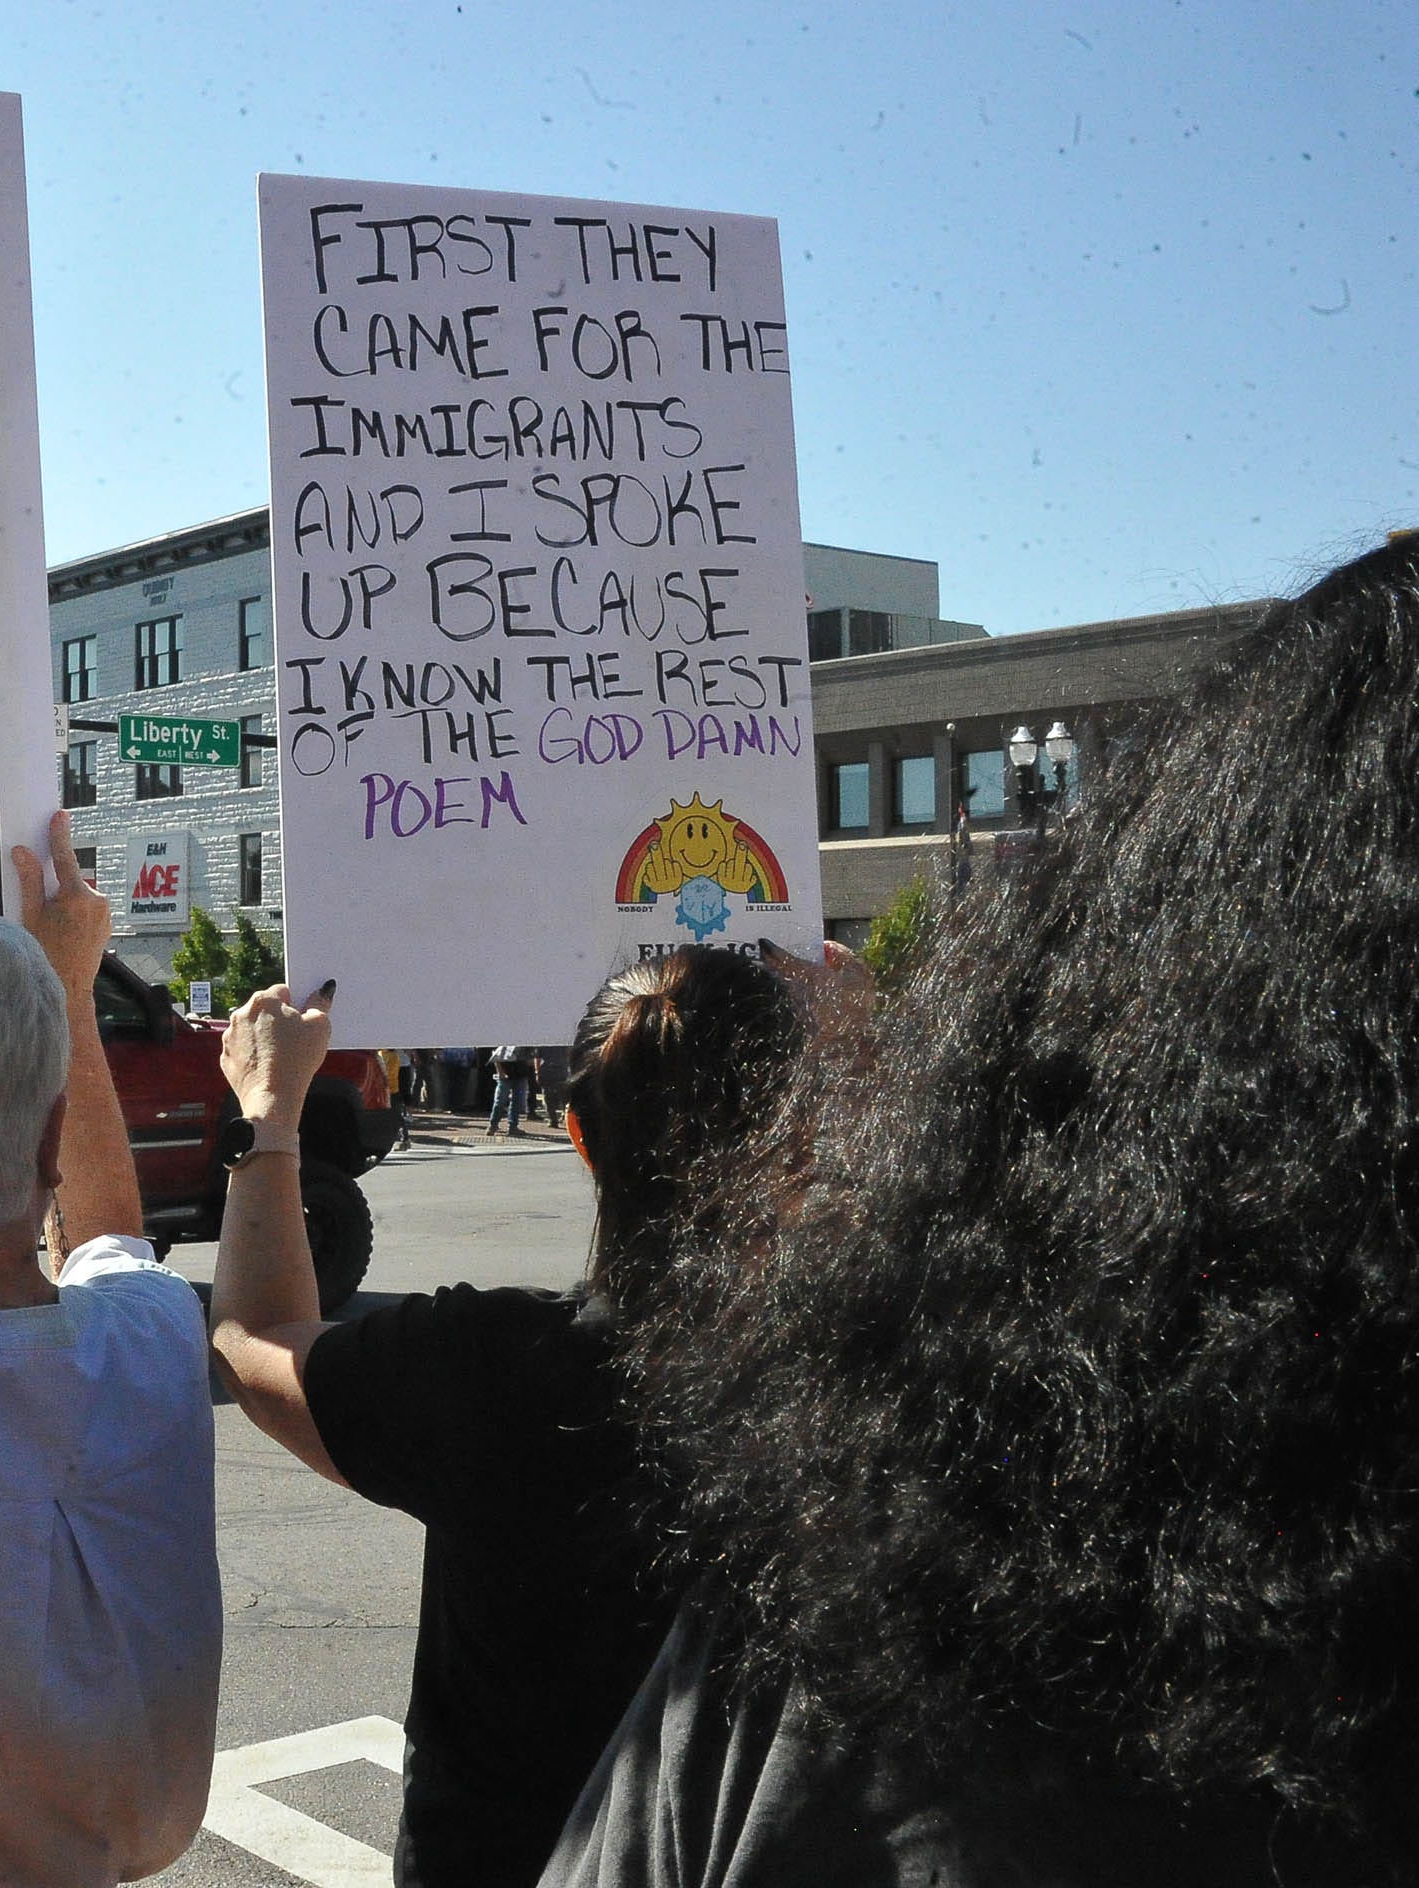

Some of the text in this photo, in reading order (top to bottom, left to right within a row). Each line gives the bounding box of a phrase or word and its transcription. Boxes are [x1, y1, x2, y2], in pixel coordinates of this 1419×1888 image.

[310, 204, 716, 294] FIRST THEY
[314, 304, 791, 382] CAME FOR THE
[290, 395, 702, 462] IMMIGRANTS
[294, 464, 757, 557] AND I SPOKE
[301, 552, 749, 645] UP BECAUSE
[285, 649, 802, 716] I KNOW THE REST
[130, 719, 230, 750] Liberty St.
[157, 749, 204, 760] EAST WEST
[291, 707, 802, 777] OF THE GOD DAMN
[359, 771, 527, 840] POEM
[132, 860, 180, 899] ACE
[146, 842, 167, 856] E&H
[130, 901, 177, 914] Hardware
[638, 943, 714, 962] FU
